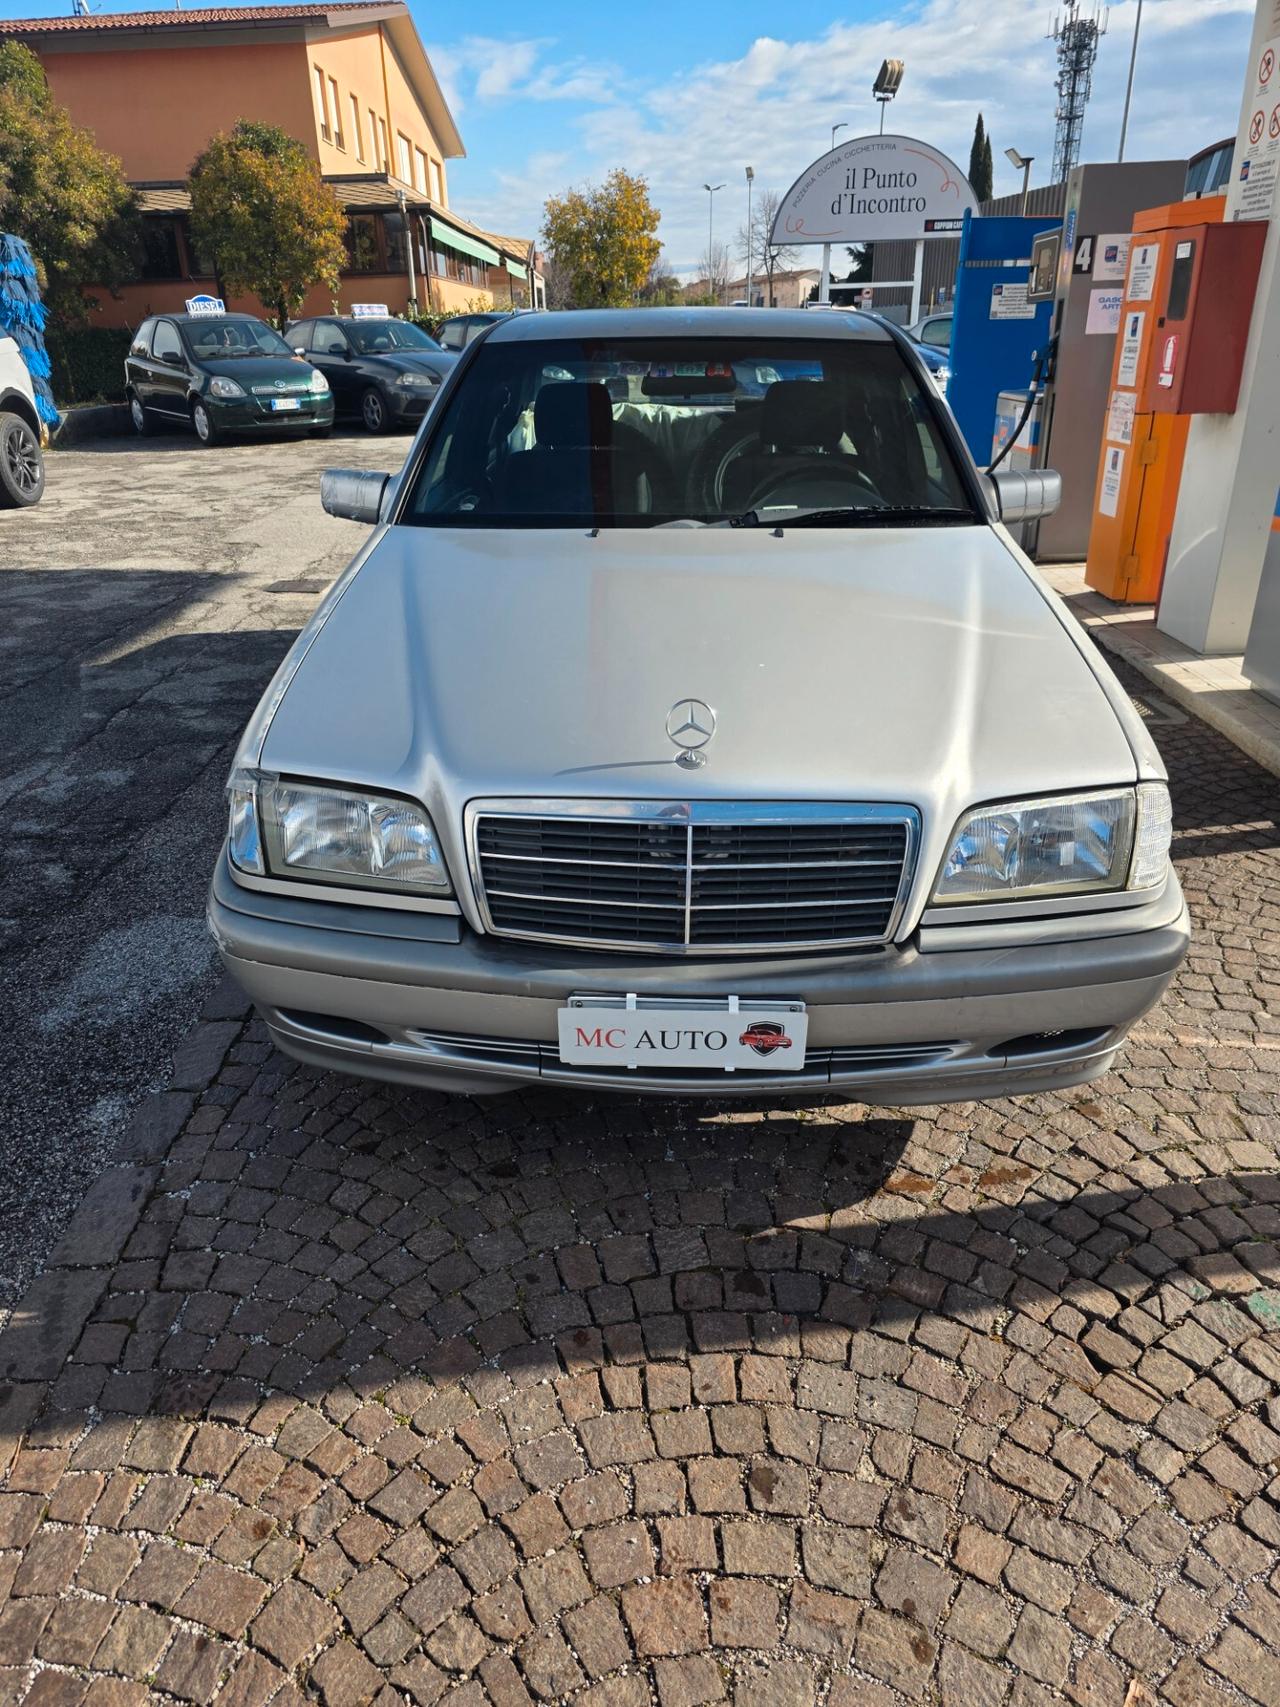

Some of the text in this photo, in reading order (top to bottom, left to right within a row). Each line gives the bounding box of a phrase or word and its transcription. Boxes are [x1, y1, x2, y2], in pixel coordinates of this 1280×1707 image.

[816, 156, 842, 177] CUCINA
[844, 143, 897, 160] CICCHETTERIA
[845, 167, 917, 190] il Punto
[831, 193, 927, 215] d'Incontro
[1075, 237, 1093, 271] 4
[189, 301, 223, 312] DIESEL
[575, 1027, 728, 1051] MC AUTO
